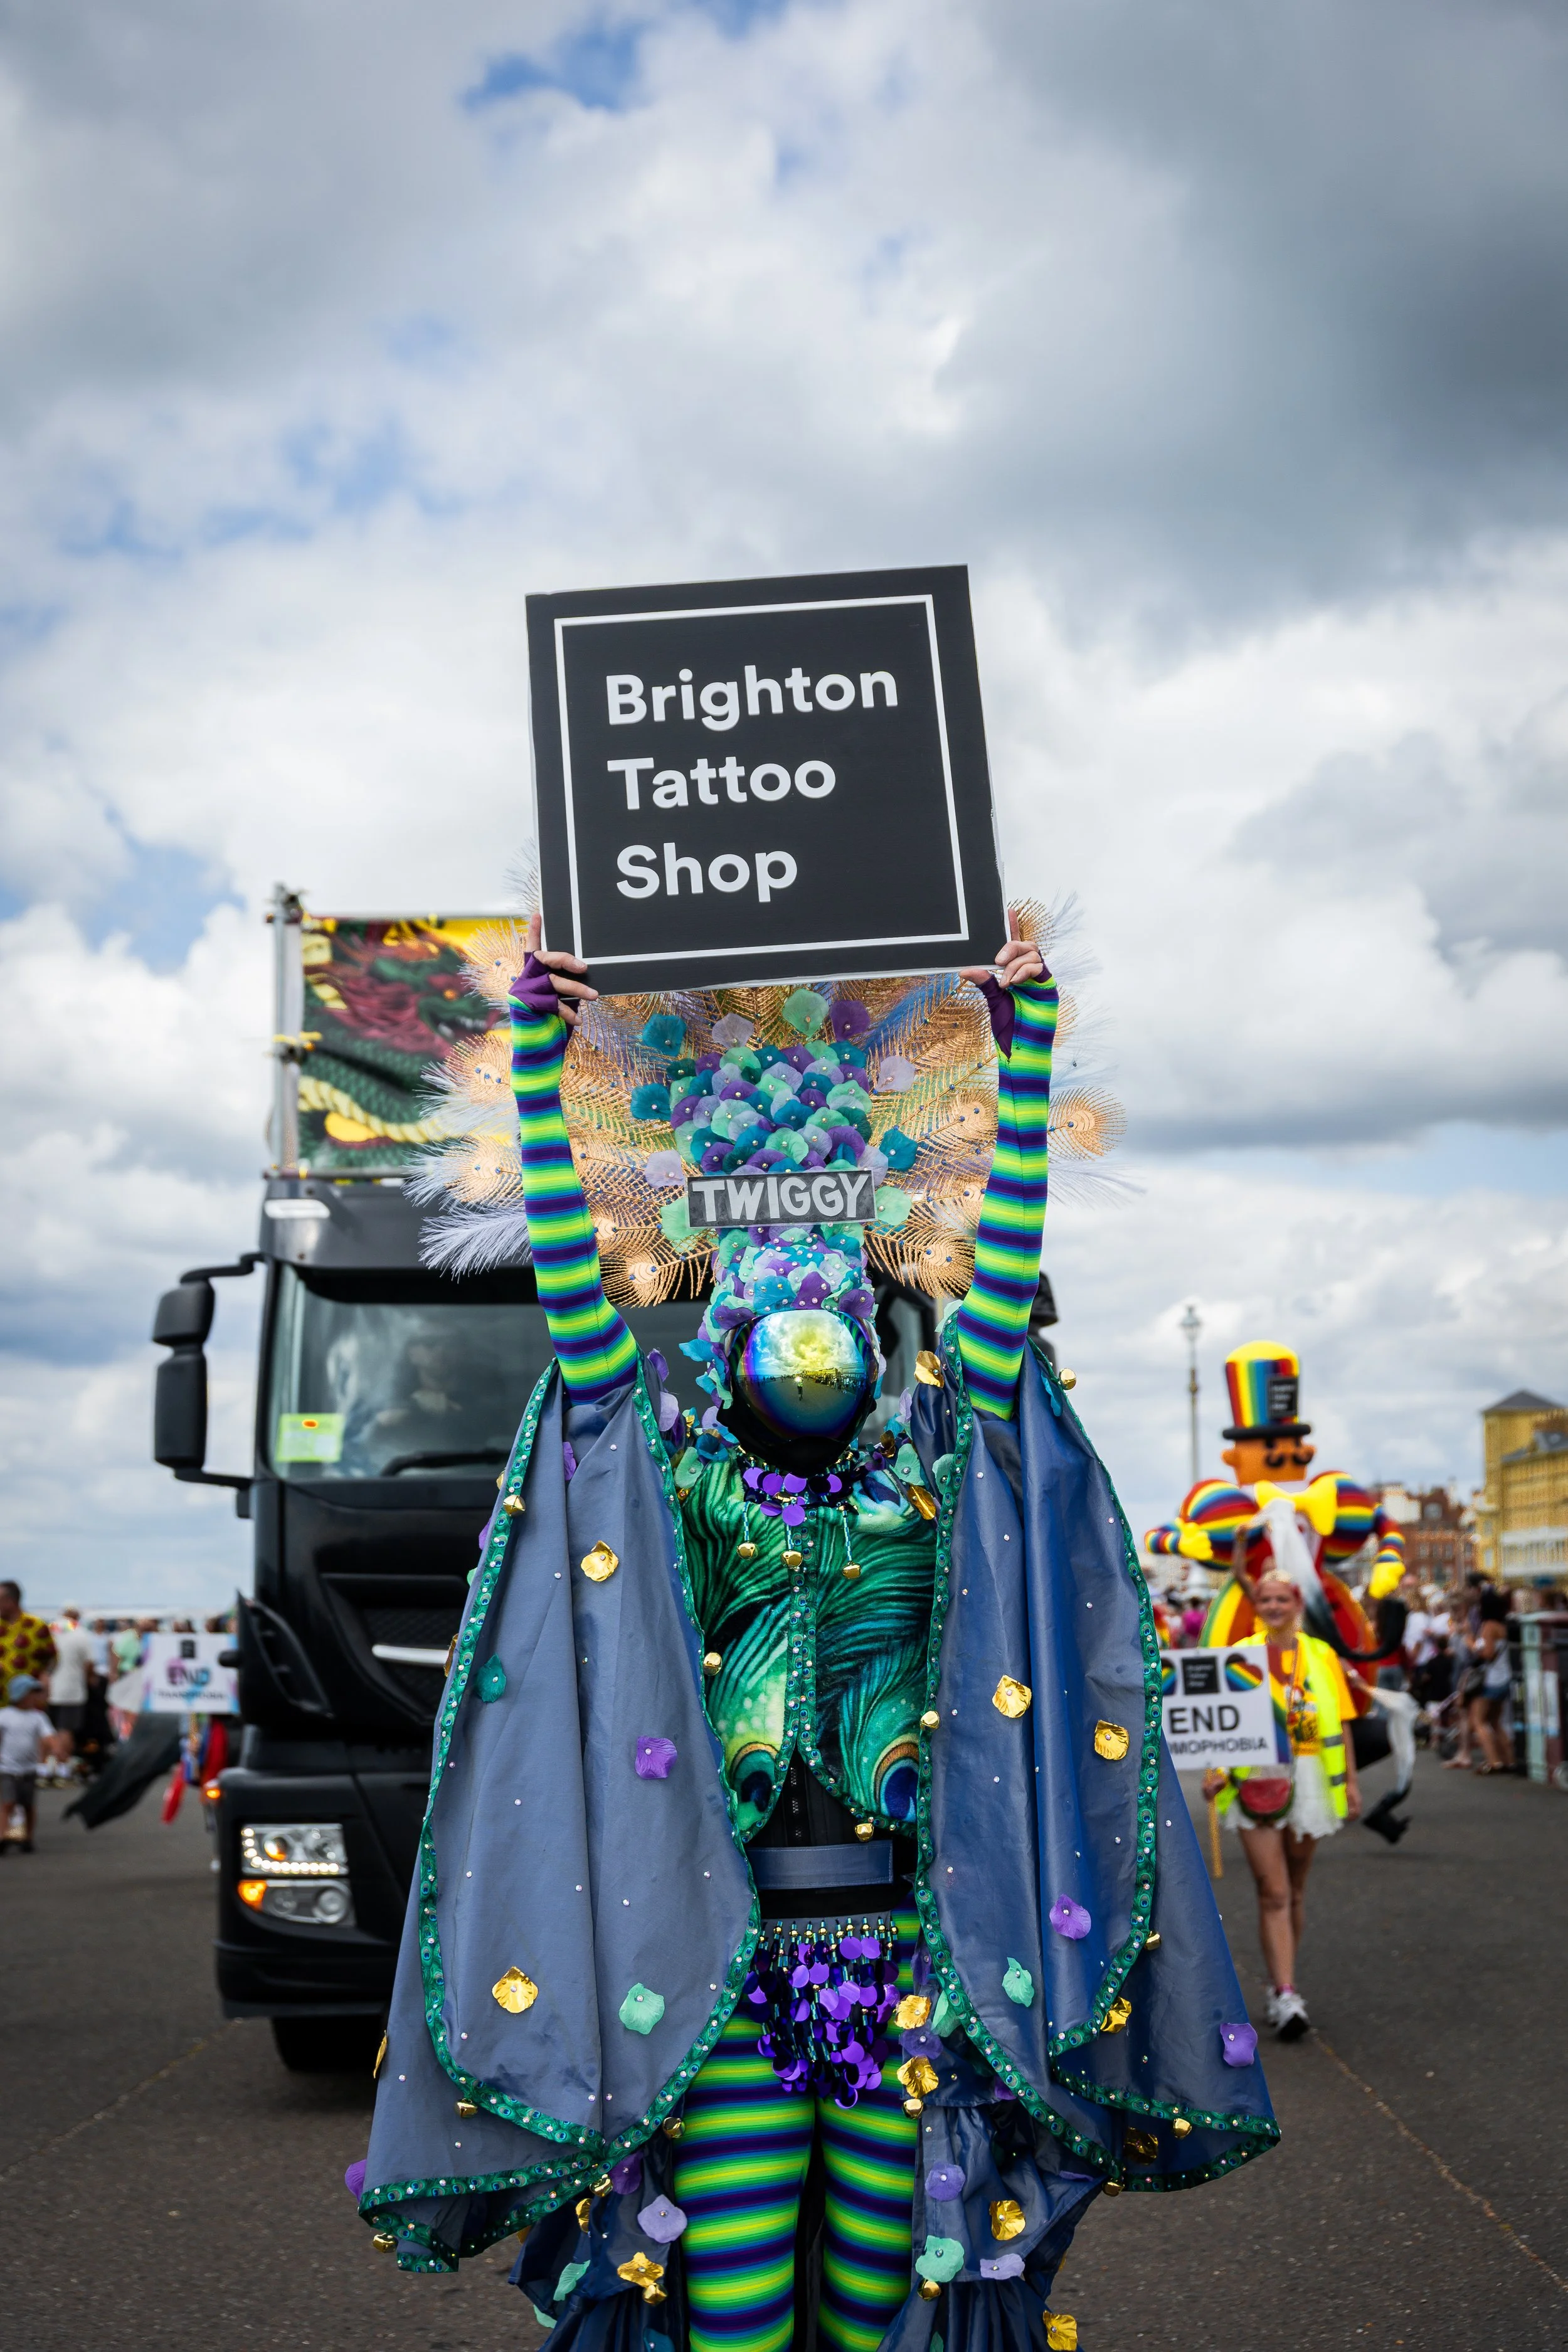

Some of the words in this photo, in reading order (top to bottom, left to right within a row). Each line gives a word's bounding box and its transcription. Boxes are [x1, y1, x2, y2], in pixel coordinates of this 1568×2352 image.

[606, 665, 898, 731] Brighton
[607, 756, 836, 810] Tattoo
[617, 842, 797, 903] Shop
[692, 1173, 869, 1222] TWIGGY
[1168, 1705, 1241, 1734] END
[1169, 1737, 1268, 1754] MOPHOBIA
